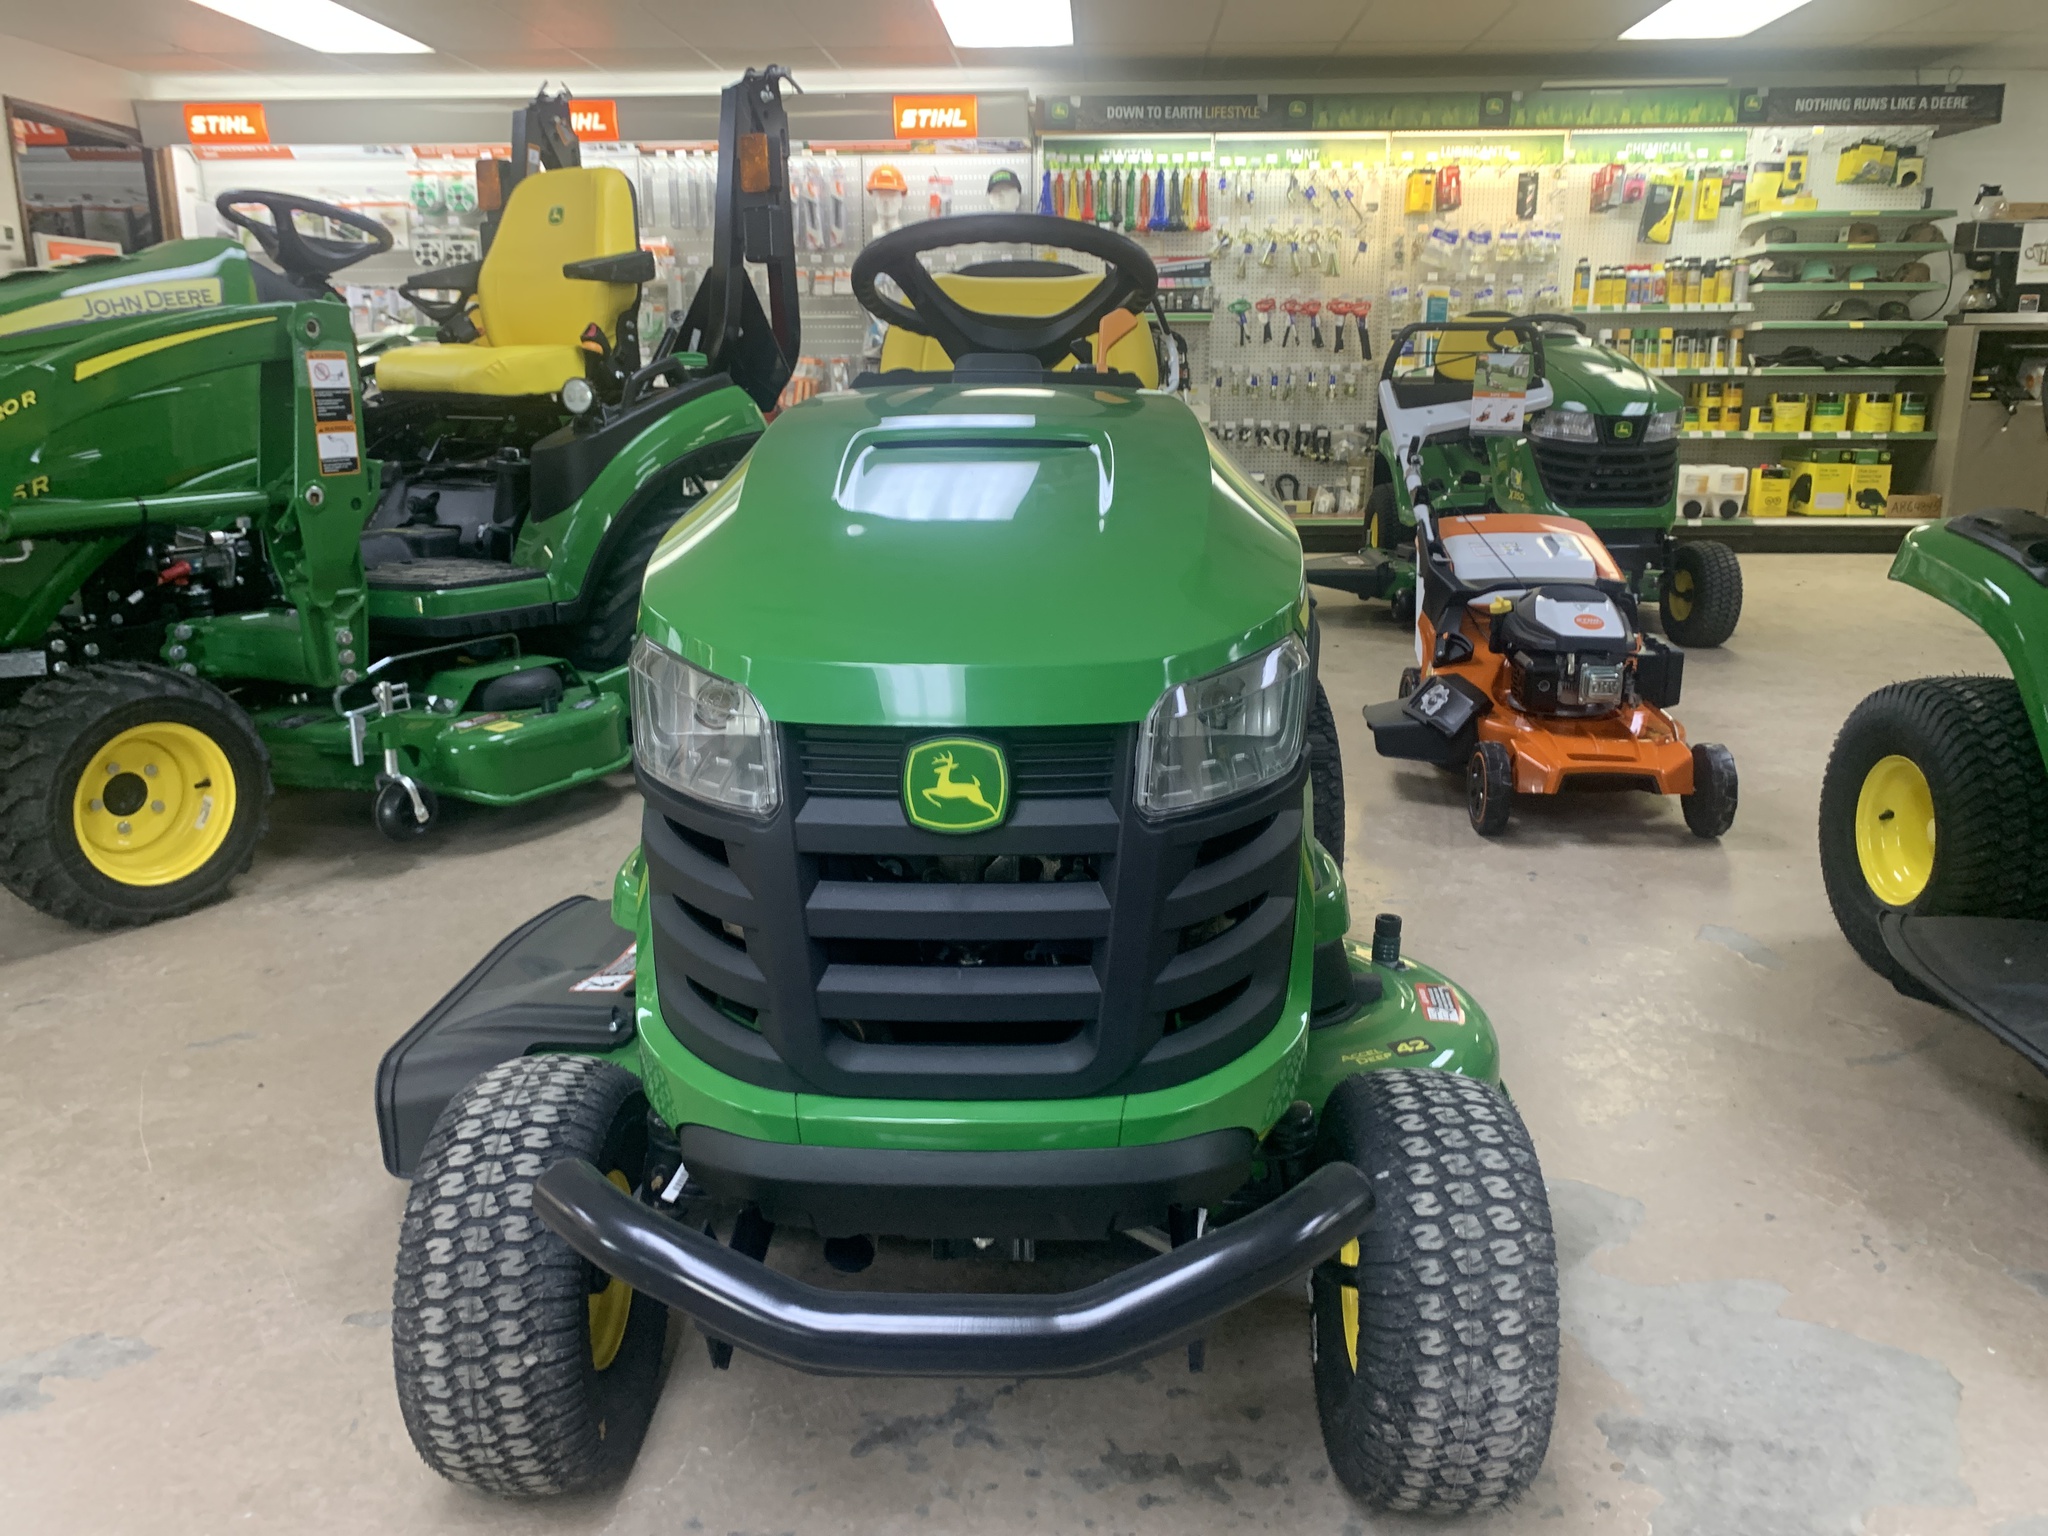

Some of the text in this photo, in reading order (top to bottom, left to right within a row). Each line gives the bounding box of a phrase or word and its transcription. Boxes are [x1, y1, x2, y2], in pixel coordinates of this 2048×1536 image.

[1794, 95, 1970, 112] NOTHING RUNS LIKE A DEERE
[901, 108, 967, 128] STIHL
[1106, 105, 1261, 119] DOWN TO EARTH LIFESTYLE
[191, 115, 256, 134] STIHL
[571, 112, 606, 131] IHL
[1624, 141, 1692, 155] CHEMICALS
[83, 288, 214, 318] JOHN DEERE
[1396, 1039, 1430, 1054] 42
[1341, 1049, 1384, 1063] ACCEL
[1355, 1052, 1392, 1066] DEEP
